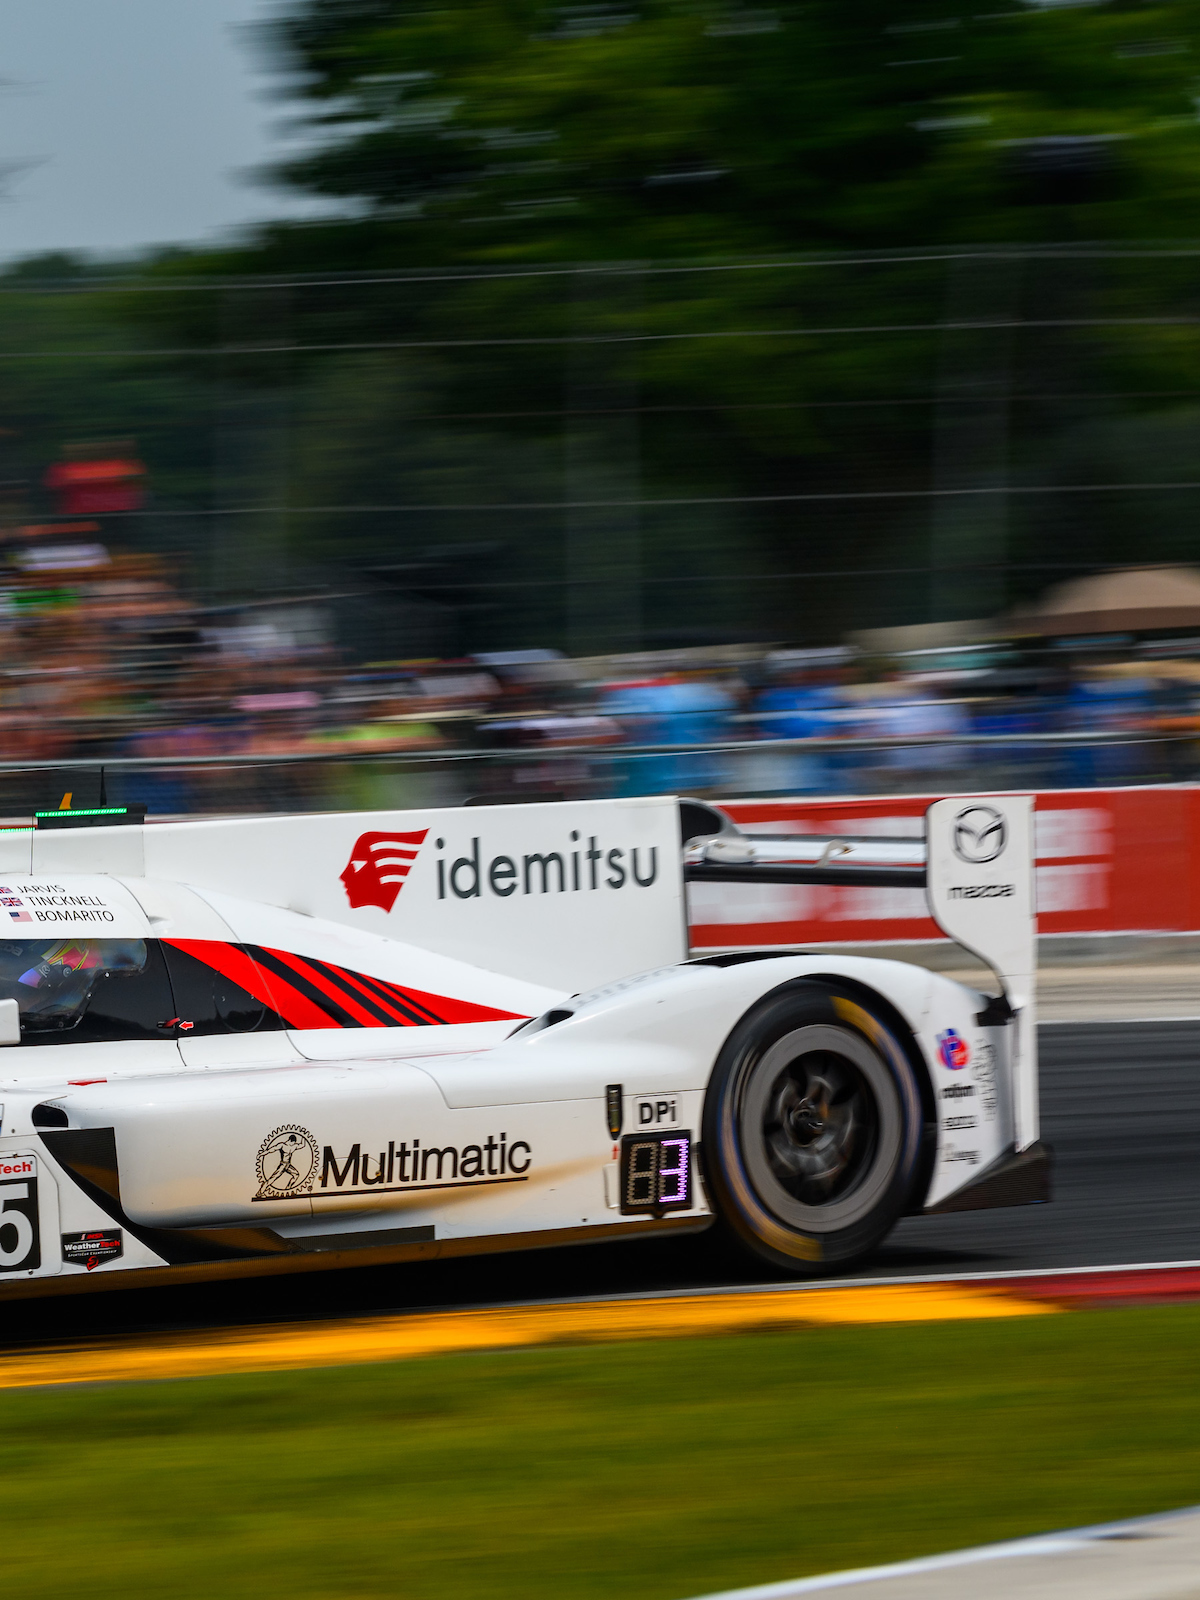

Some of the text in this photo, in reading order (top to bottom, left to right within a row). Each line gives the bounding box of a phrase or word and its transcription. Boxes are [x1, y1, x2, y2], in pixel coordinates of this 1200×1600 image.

[434, 829, 659, 900] idemitsu
[16, 884, 66, 894] JARVIS
[947, 884, 1016, 900] mazda
[25, 896, 107, 906] TINCKNELL
[34, 910, 115, 922] BOMARITO
[638, 1100, 677, 1125] DPi
[320, 1132, 532, 1188] Multimatic
[63, 1240, 121, 1251] WeatherTech
